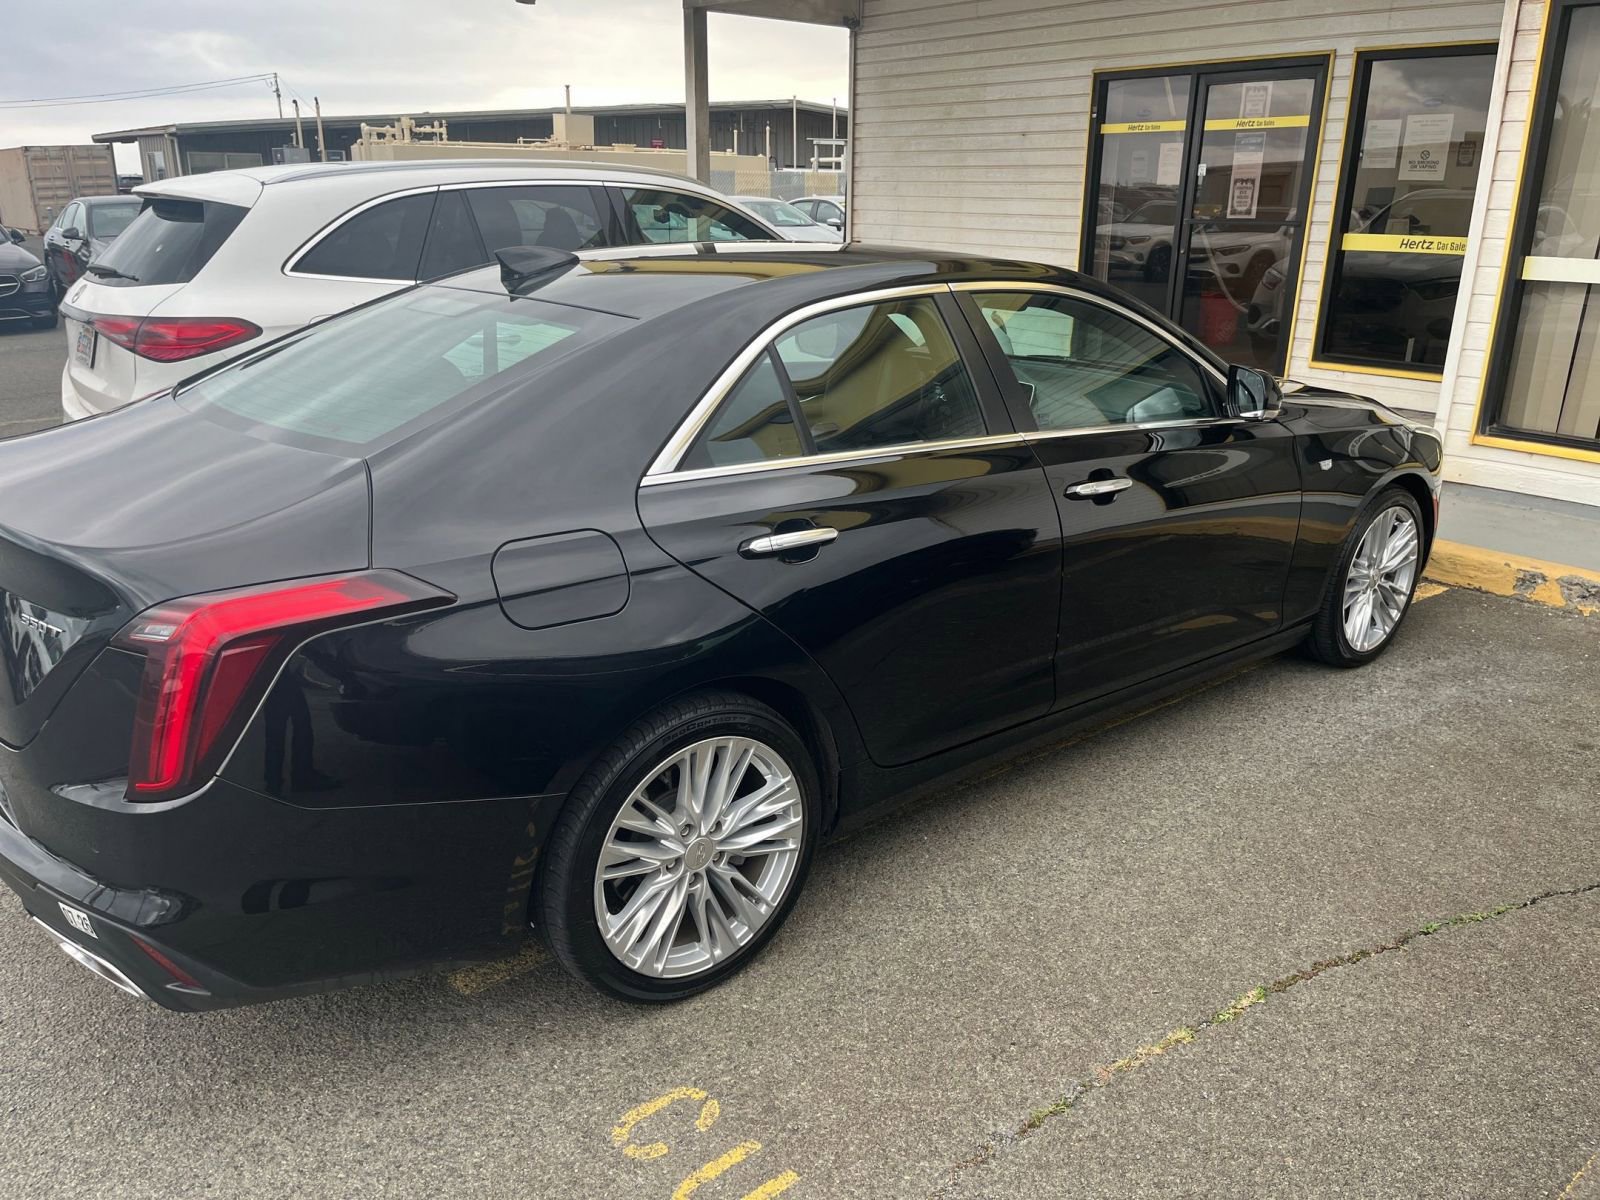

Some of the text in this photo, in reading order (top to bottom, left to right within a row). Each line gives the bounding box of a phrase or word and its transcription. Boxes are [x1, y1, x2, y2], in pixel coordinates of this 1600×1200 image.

[1127, 123, 1144, 131] Hertz
[1236, 119, 1255, 128] Hertz
[1400, 238, 1467, 252] Hertz Car Sale
